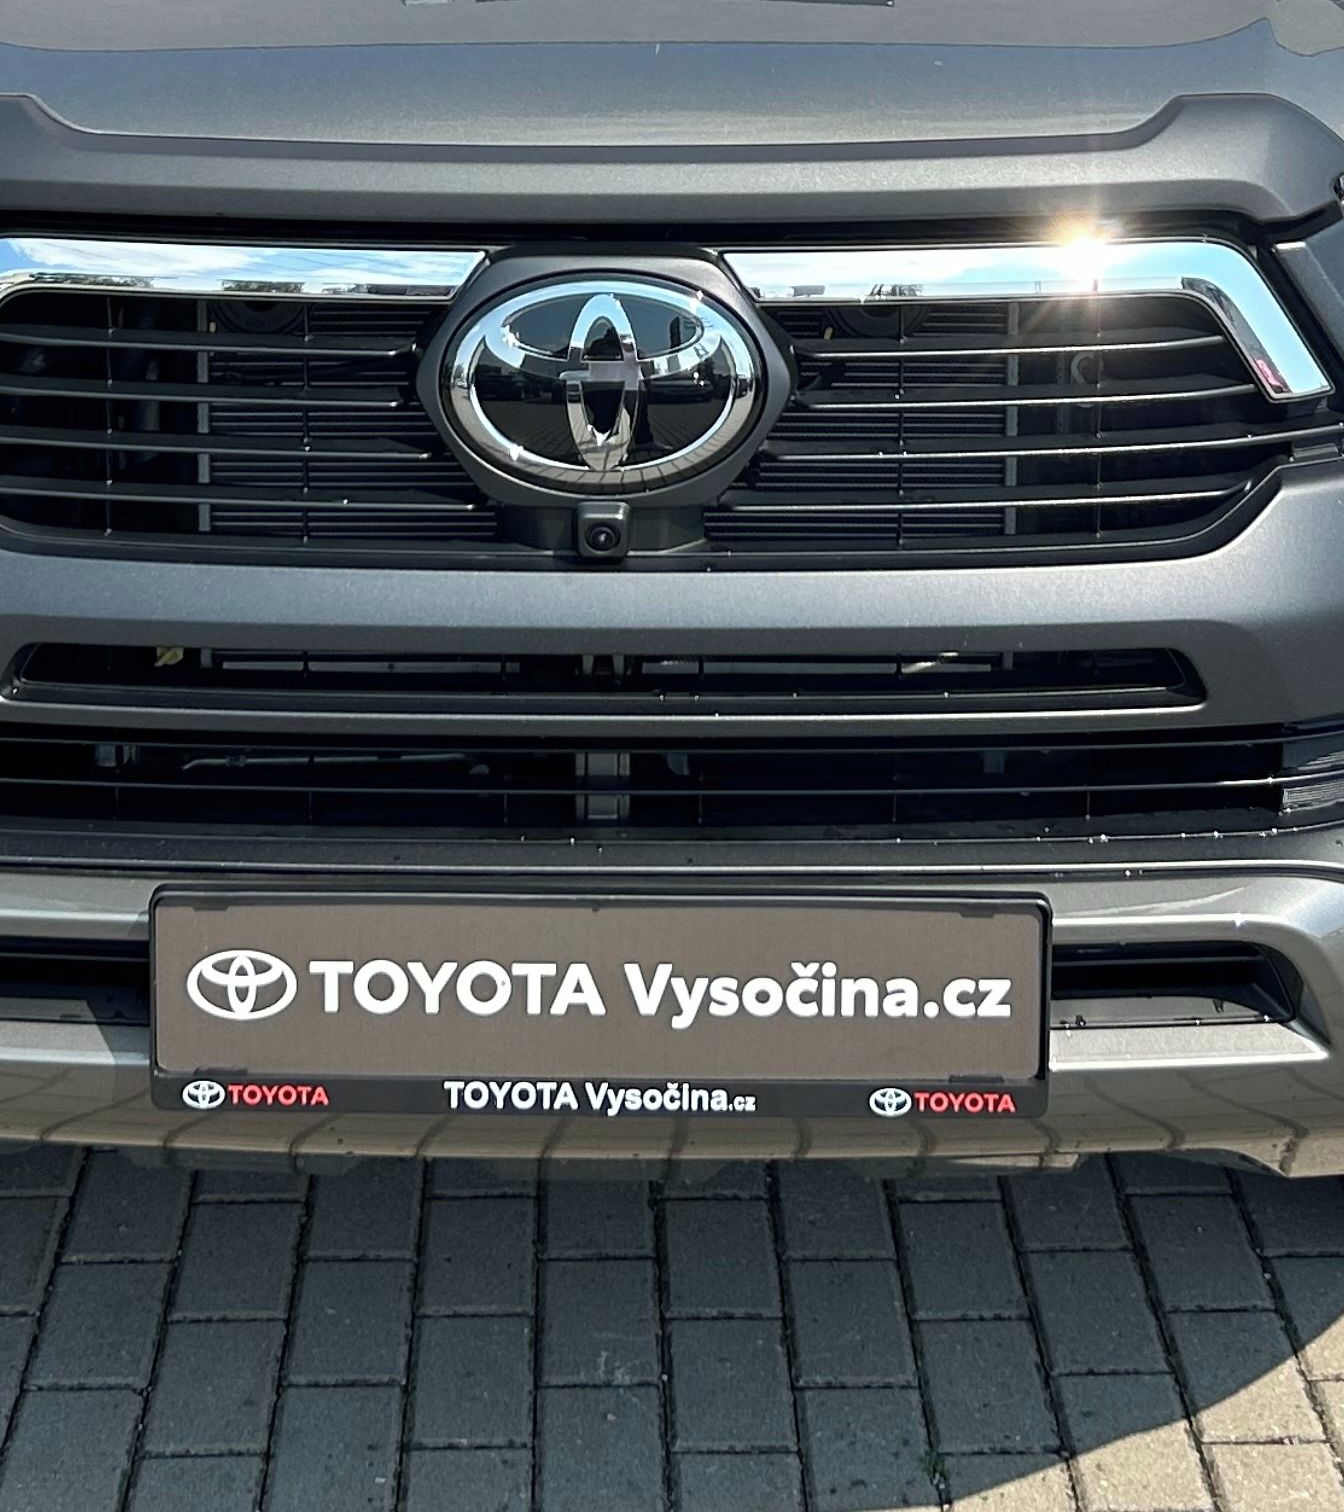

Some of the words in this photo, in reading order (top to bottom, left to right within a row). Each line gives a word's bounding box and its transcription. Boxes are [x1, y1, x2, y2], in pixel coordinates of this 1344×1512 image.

[309, 959, 606, 1016] TOYOTA
[623, 961, 1011, 1030] Vysočina.cz
[228, 1084, 329, 1106] TOYOTA
[443, 1080, 579, 1110] TOYOTA
[584, 1081, 757, 1116] Vysočina.cz
[914, 1091, 1016, 1114] TOYOTA
